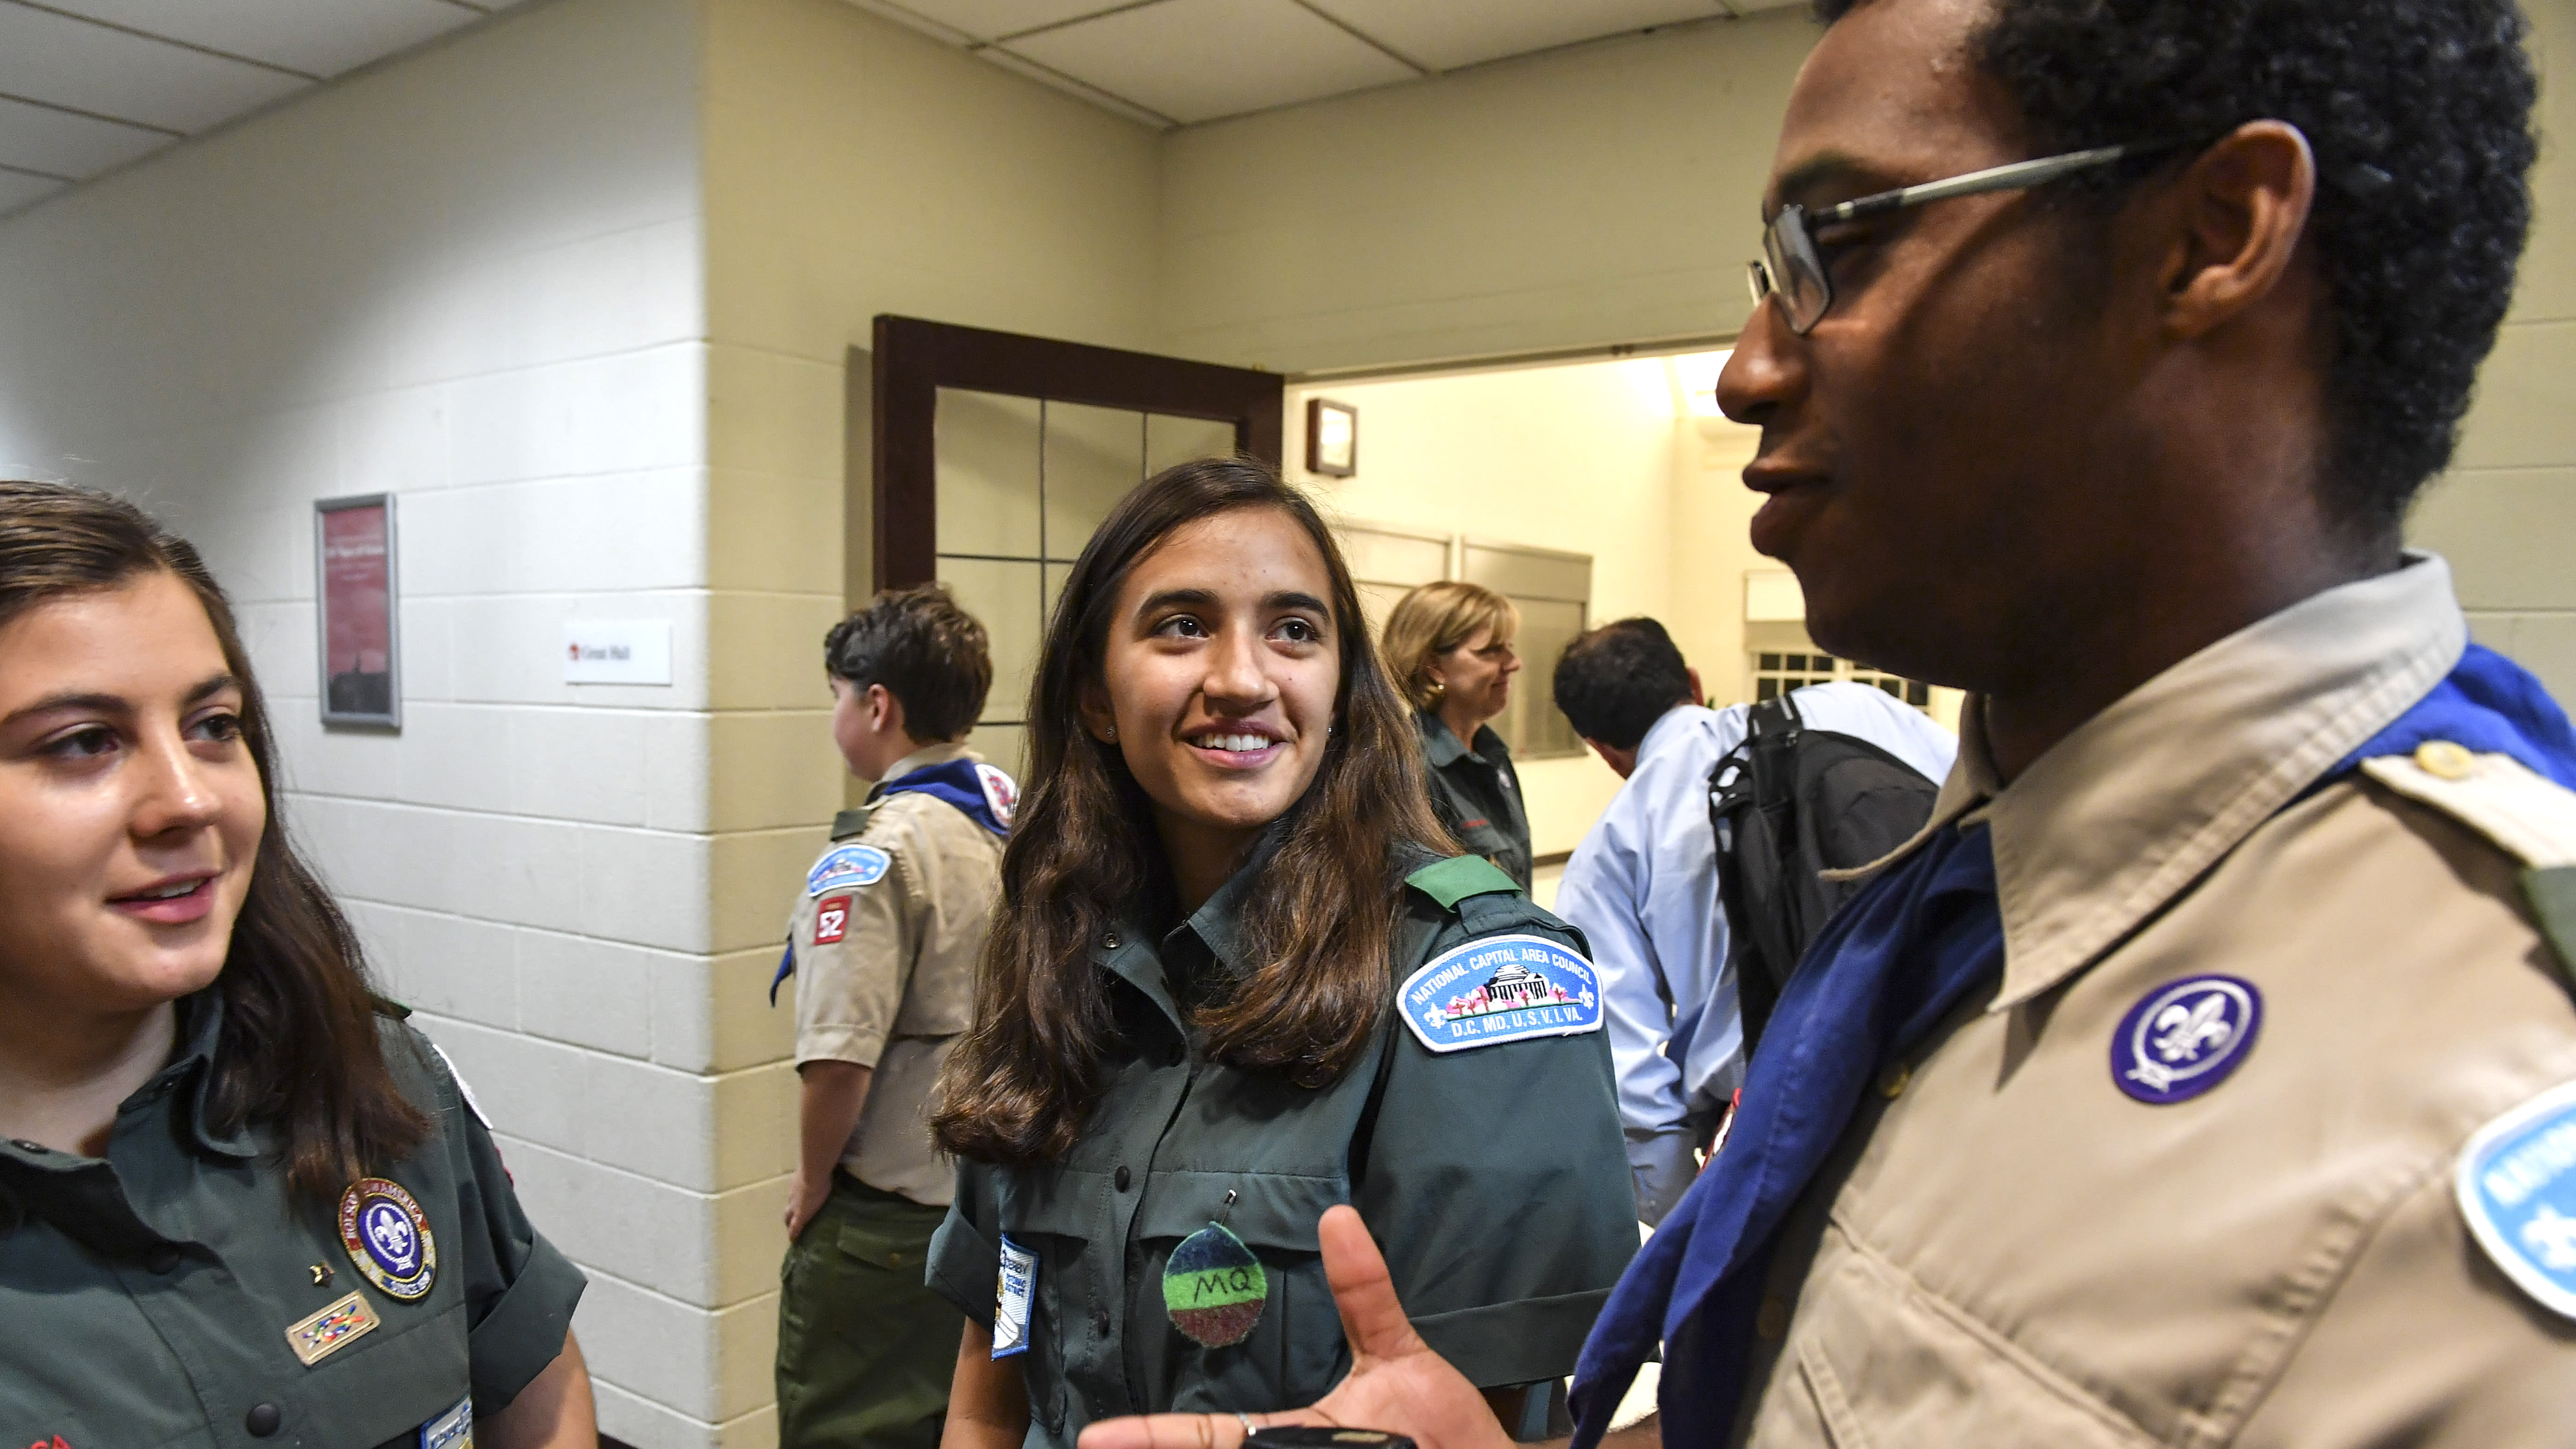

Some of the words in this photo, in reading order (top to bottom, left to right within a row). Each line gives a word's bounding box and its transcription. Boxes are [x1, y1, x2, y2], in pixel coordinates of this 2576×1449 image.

[819, 910, 845, 938] 52
[1411, 962, 1470, 1005] NATIONAL
[1470, 949, 1519, 970] CAPITAL
[1522, 948, 1549, 964] AREA
[1552, 954, 1592, 985] COUNCIL
[1451, 1020, 1481, 1037] D.C.
[1483, 1016, 1510, 1033] MD.
[1194, 1267, 1252, 1303] MQ
